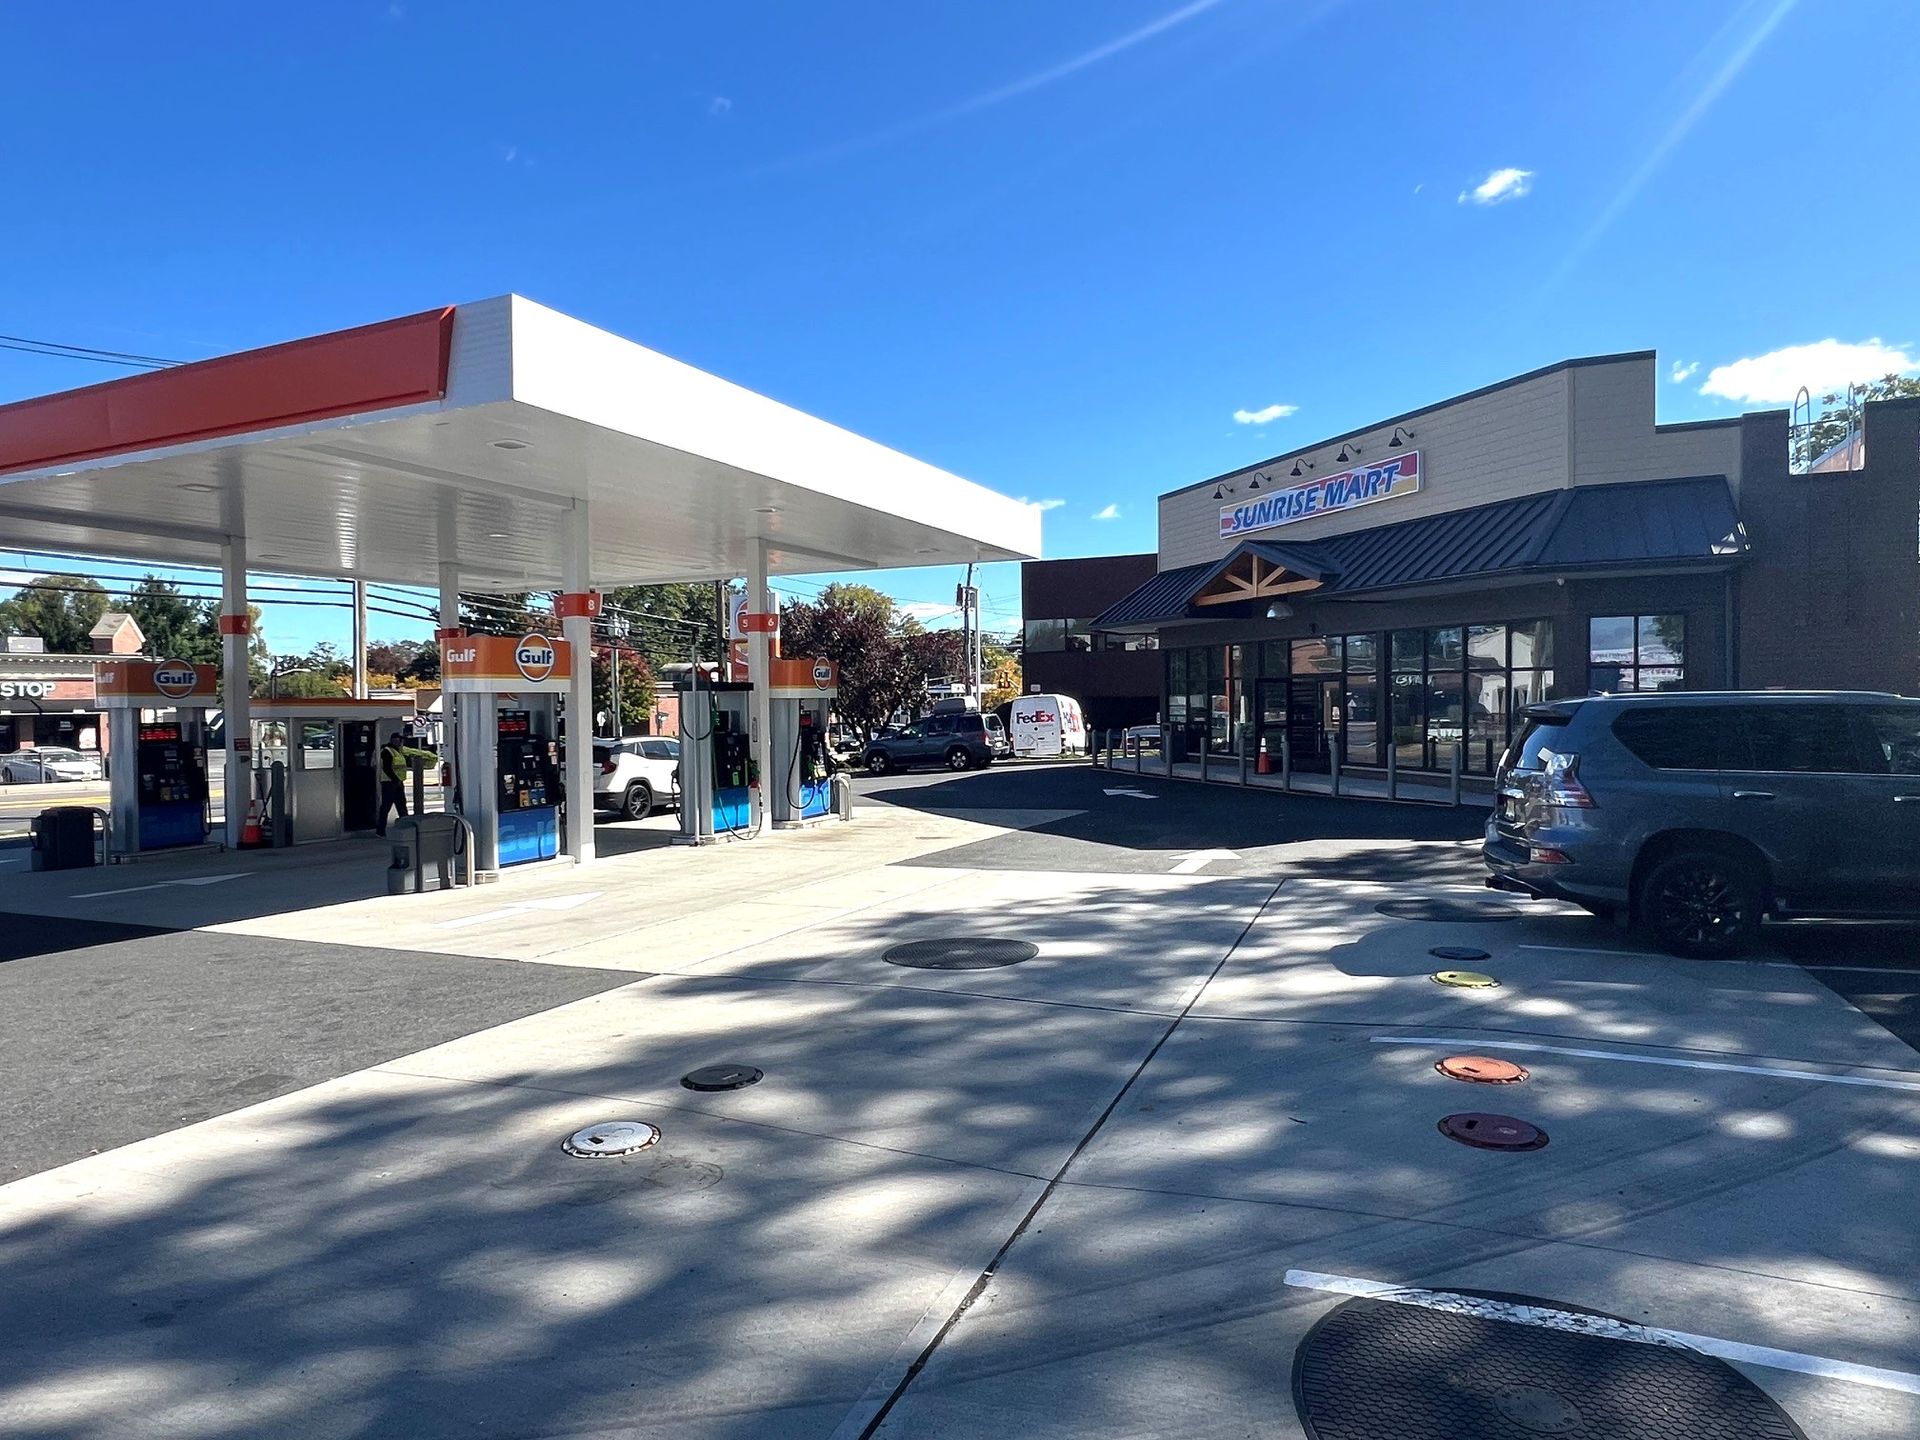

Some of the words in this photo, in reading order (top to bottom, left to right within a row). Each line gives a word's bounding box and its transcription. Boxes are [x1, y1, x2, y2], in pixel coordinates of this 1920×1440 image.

[1232, 486, 1320, 531] SUNRISE
[1322, 463, 1401, 508] MART
[588, 600, 596, 610] 8
[742, 618, 748, 627] 5
[768, 618, 775, 626] 6
[447, 648, 476, 663] Gulf
[518, 649, 553, 665] Gulf
[156, 672, 195, 684] Gulf
[814, 668, 830, 678] Gulf
[1, 682, 56, 697] STOP
[1016, 710, 1055, 724] FedEx
